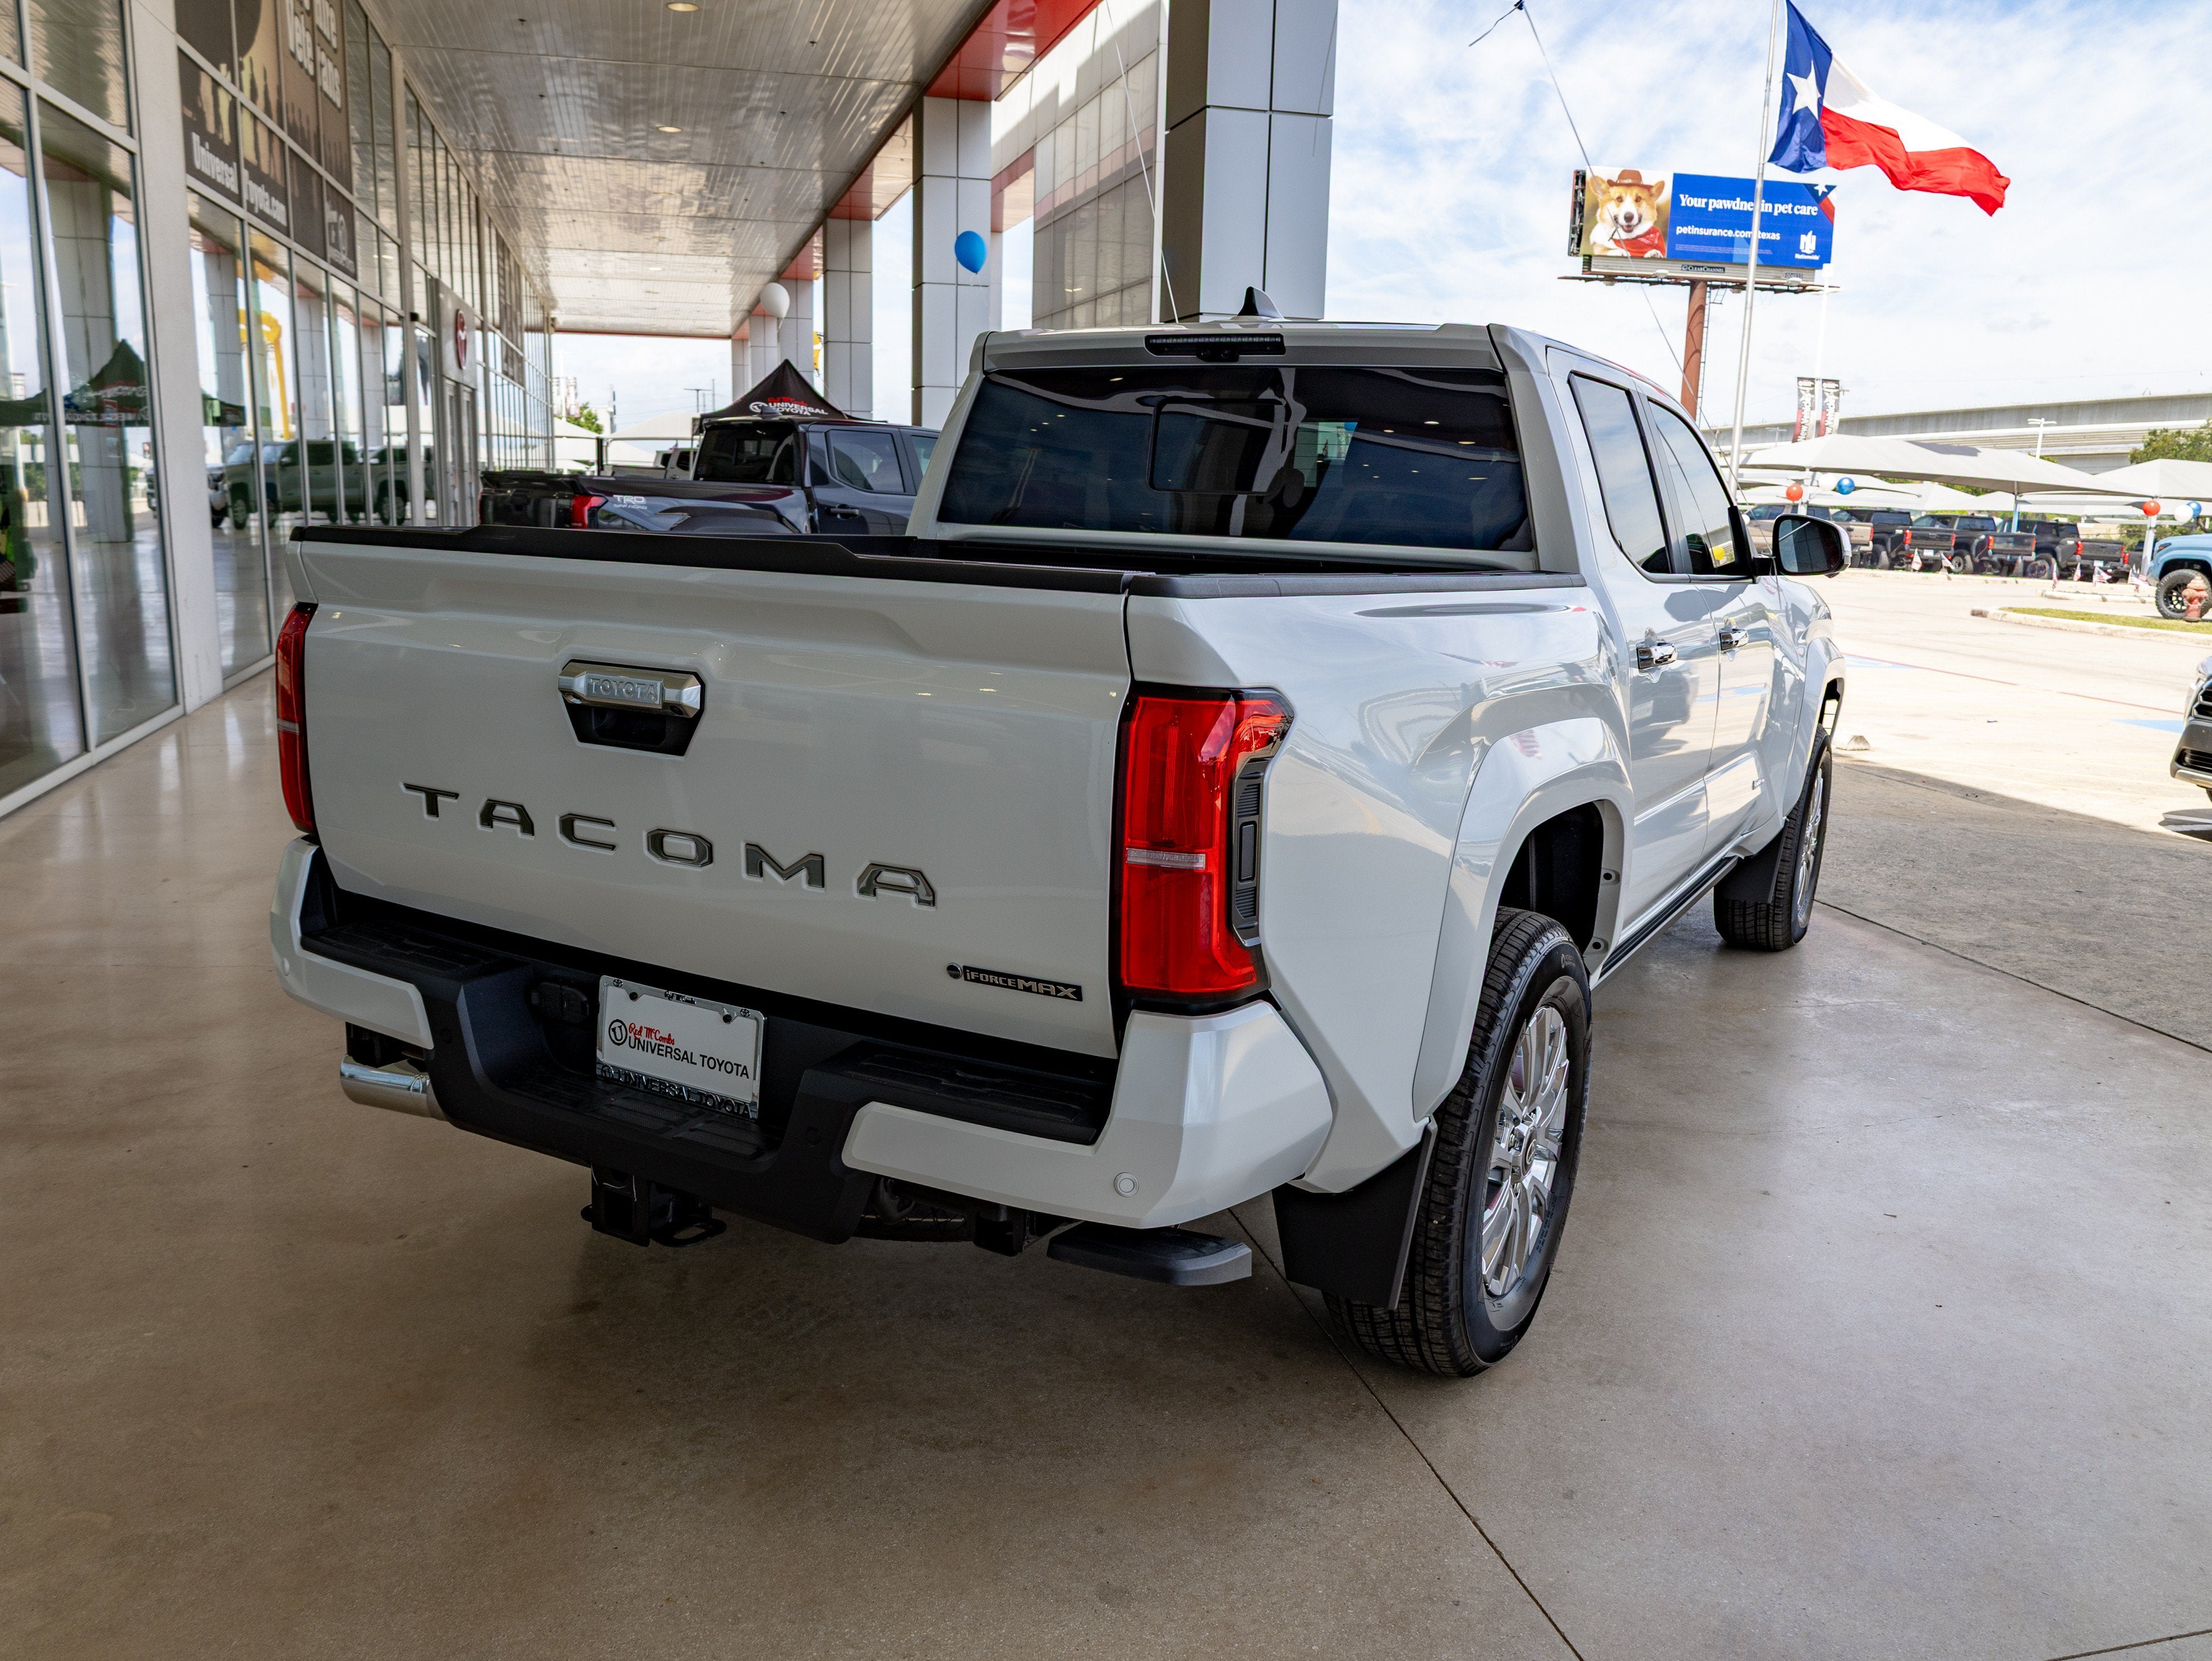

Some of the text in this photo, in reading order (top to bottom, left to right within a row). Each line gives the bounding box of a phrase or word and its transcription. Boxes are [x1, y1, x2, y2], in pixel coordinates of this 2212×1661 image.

[1679, 194, 1819, 216] Your pawdne in pet care
[1676, 225, 1781, 241] petinsurance.comtexas
[768, 402, 829, 415] UNIVERSAL
[775, 407, 811, 416] OYOTA
[613, 494, 646, 505] TRD
[590, 678, 658, 701] TOYOTA
[402, 782, 935, 908] TACOMA
[628, 1022, 675, 1046] Red McCombs
[628, 1035, 749, 1080] UNIVERSAL TOYOTA
[618, 1069, 753, 1119] UNIVERSAL TOYOTA
